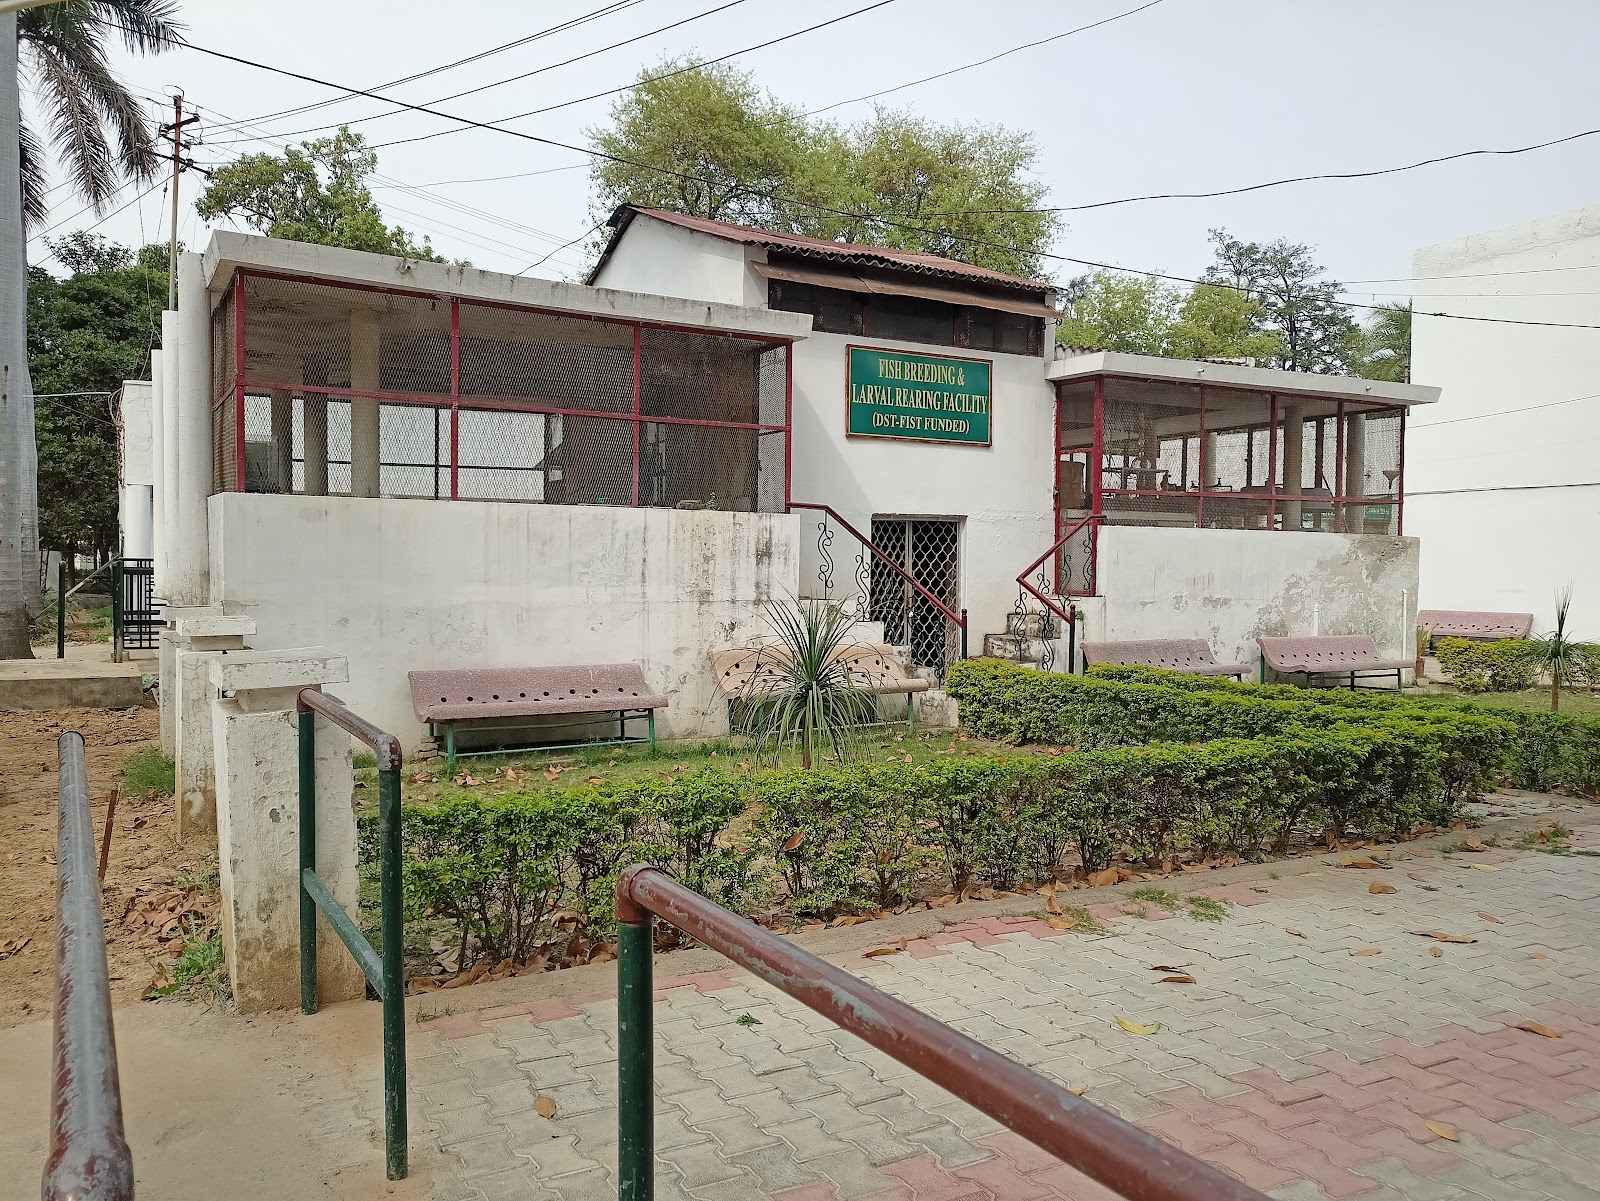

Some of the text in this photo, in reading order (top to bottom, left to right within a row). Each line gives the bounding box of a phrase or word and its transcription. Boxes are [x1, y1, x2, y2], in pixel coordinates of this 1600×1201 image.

[878, 358, 965, 386] FISH BREEDING &
[852, 384, 988, 414] LARVAL REARING FACILITY
[872, 412, 970, 434] (DST-FIST FUNDED)
